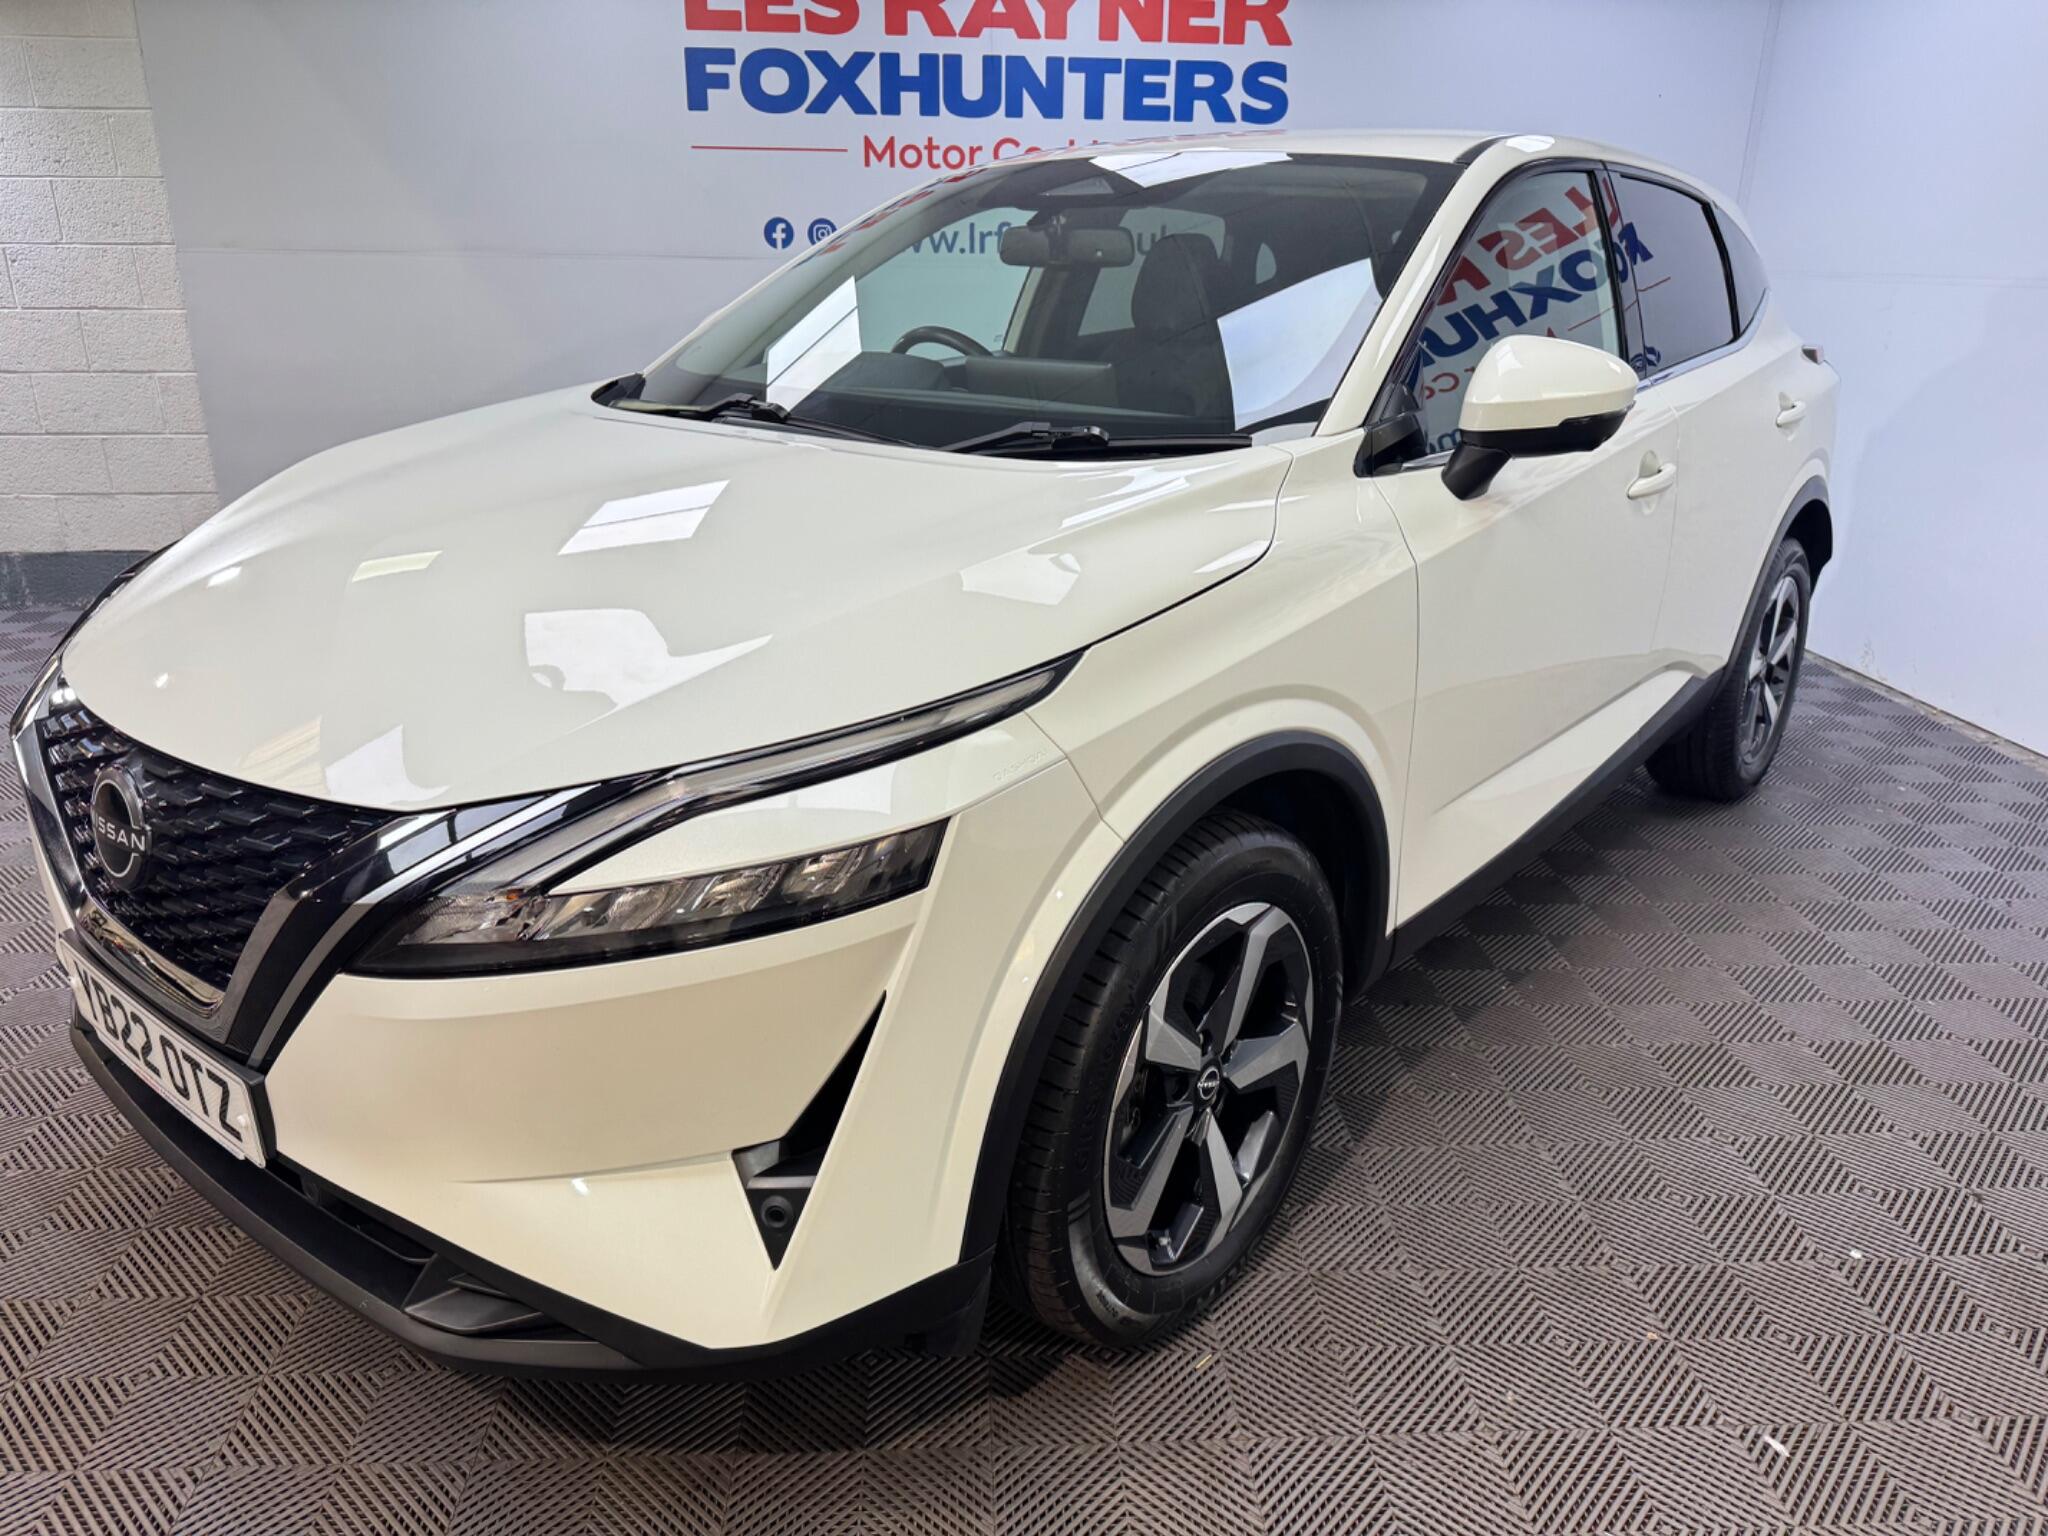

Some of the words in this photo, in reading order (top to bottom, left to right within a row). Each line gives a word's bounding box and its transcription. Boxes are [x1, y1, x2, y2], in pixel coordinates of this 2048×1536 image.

[684, 47, 1290, 125] FOXHUNTERS
[864, 136, 983, 170] Motor
[73, 959, 161, 1079] YB22
[159, 1034, 243, 1142] OTZ
